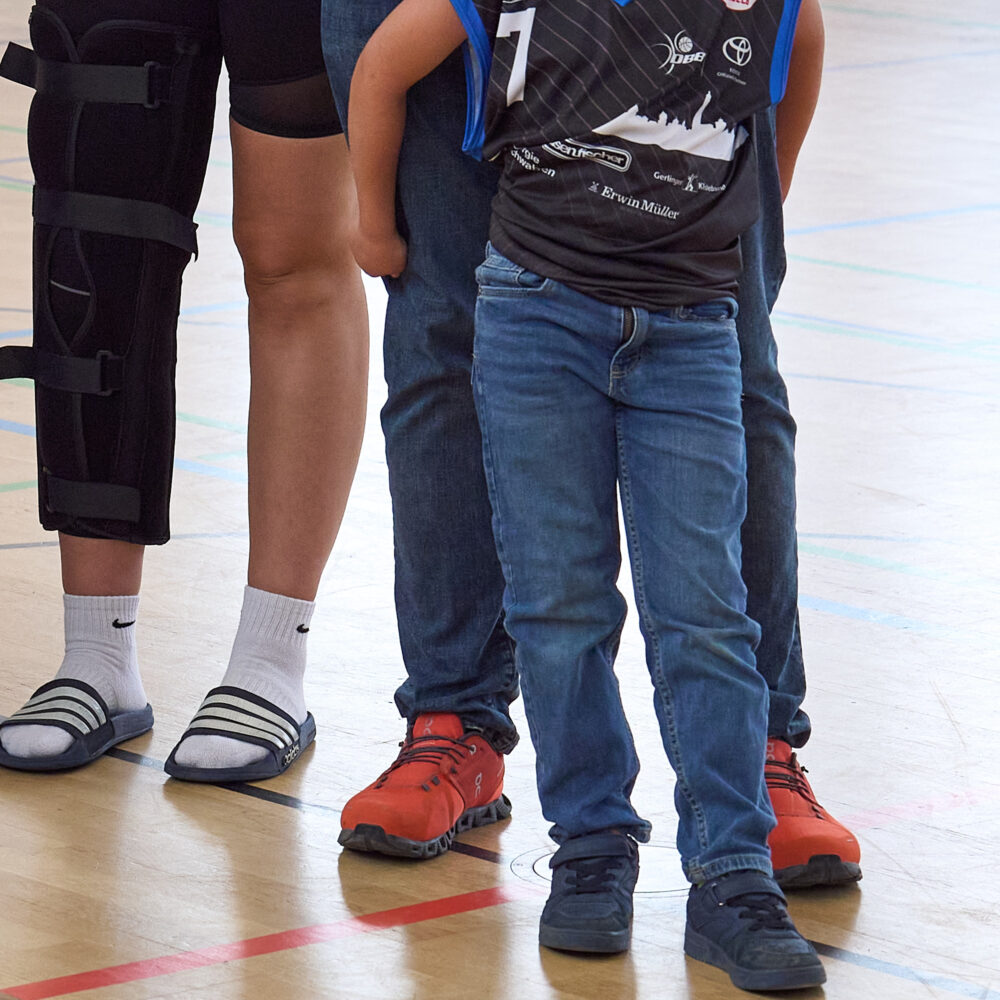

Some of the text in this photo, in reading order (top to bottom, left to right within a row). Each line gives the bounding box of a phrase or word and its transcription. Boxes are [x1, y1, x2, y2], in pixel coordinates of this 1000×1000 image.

[670, 51, 706, 64] DBB
[601, 185, 680, 220] Erwin Müller
